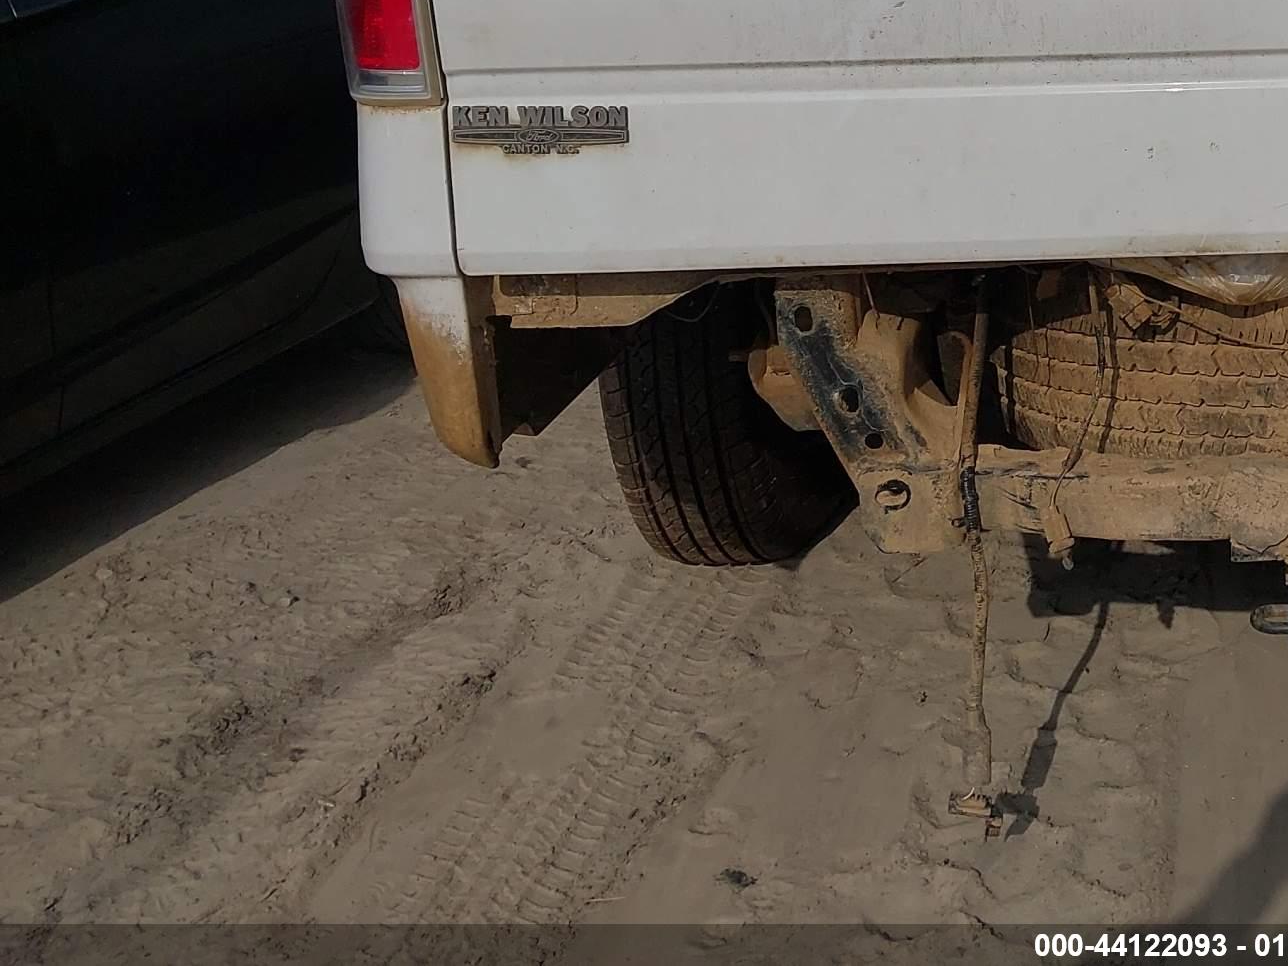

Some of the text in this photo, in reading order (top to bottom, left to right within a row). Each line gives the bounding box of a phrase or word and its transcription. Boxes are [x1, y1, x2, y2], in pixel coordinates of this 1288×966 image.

[452, 105, 629, 127] KEN WILSON
[502, 144, 550, 154] CANTON
